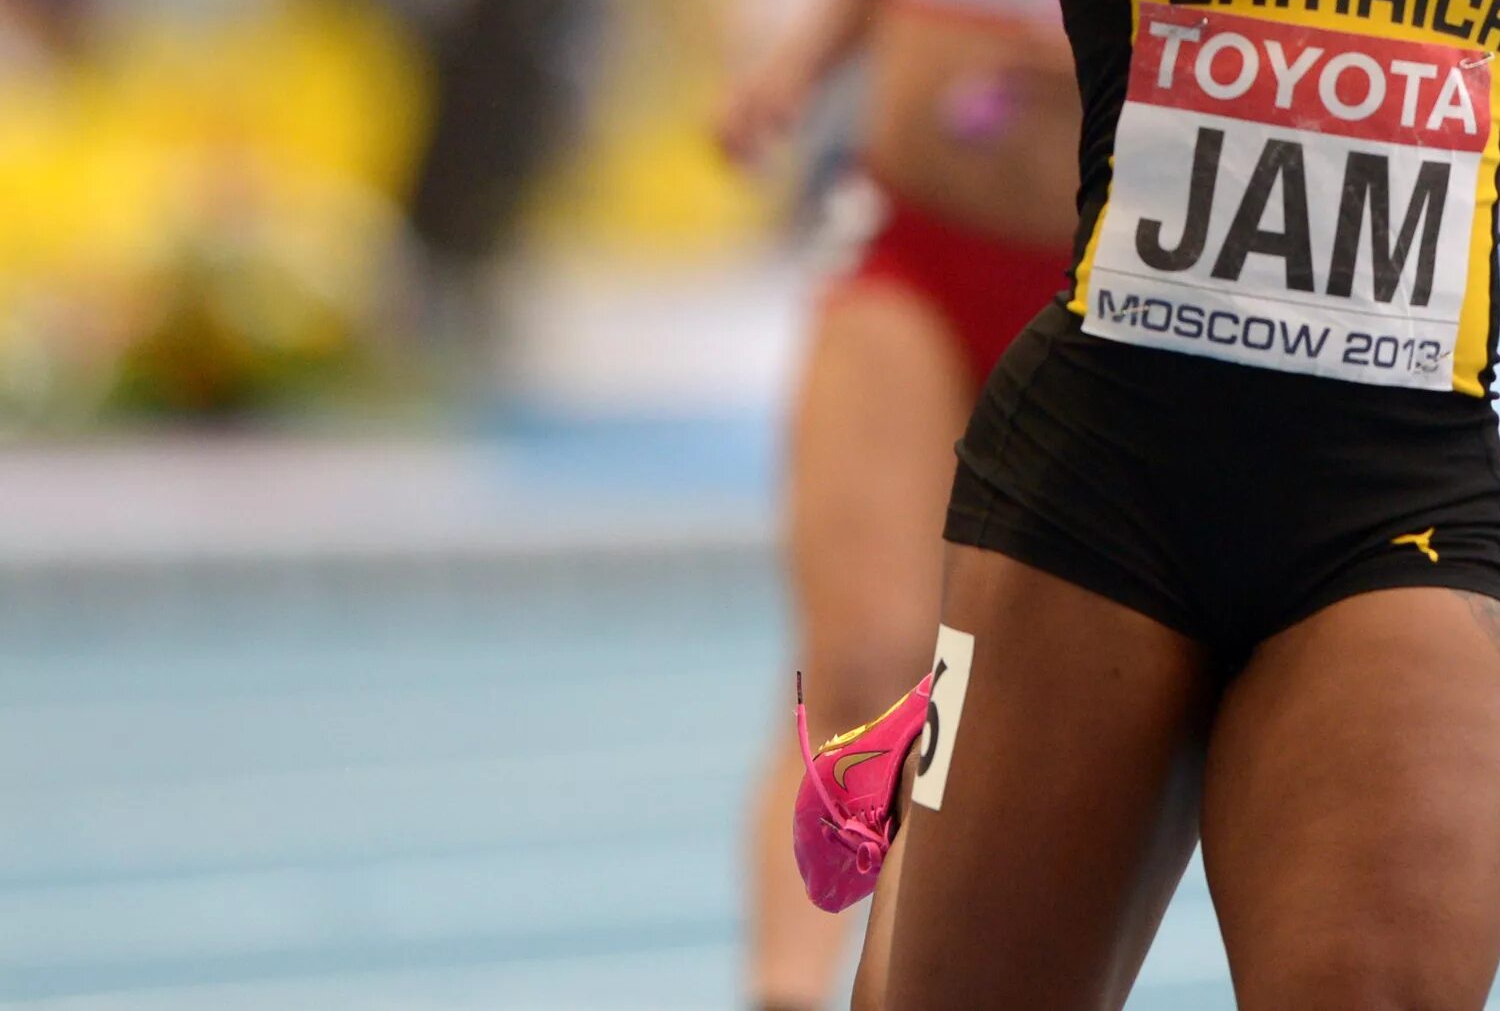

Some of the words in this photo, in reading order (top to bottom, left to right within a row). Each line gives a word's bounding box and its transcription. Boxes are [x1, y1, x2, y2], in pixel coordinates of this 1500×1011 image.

[1149, 22, 1477, 135] TOYOTA
[1135, 127, 1451, 307] JAM
[1098, 289, 1330, 358] MOSCOW
[1342, 332, 1441, 372] 2013
